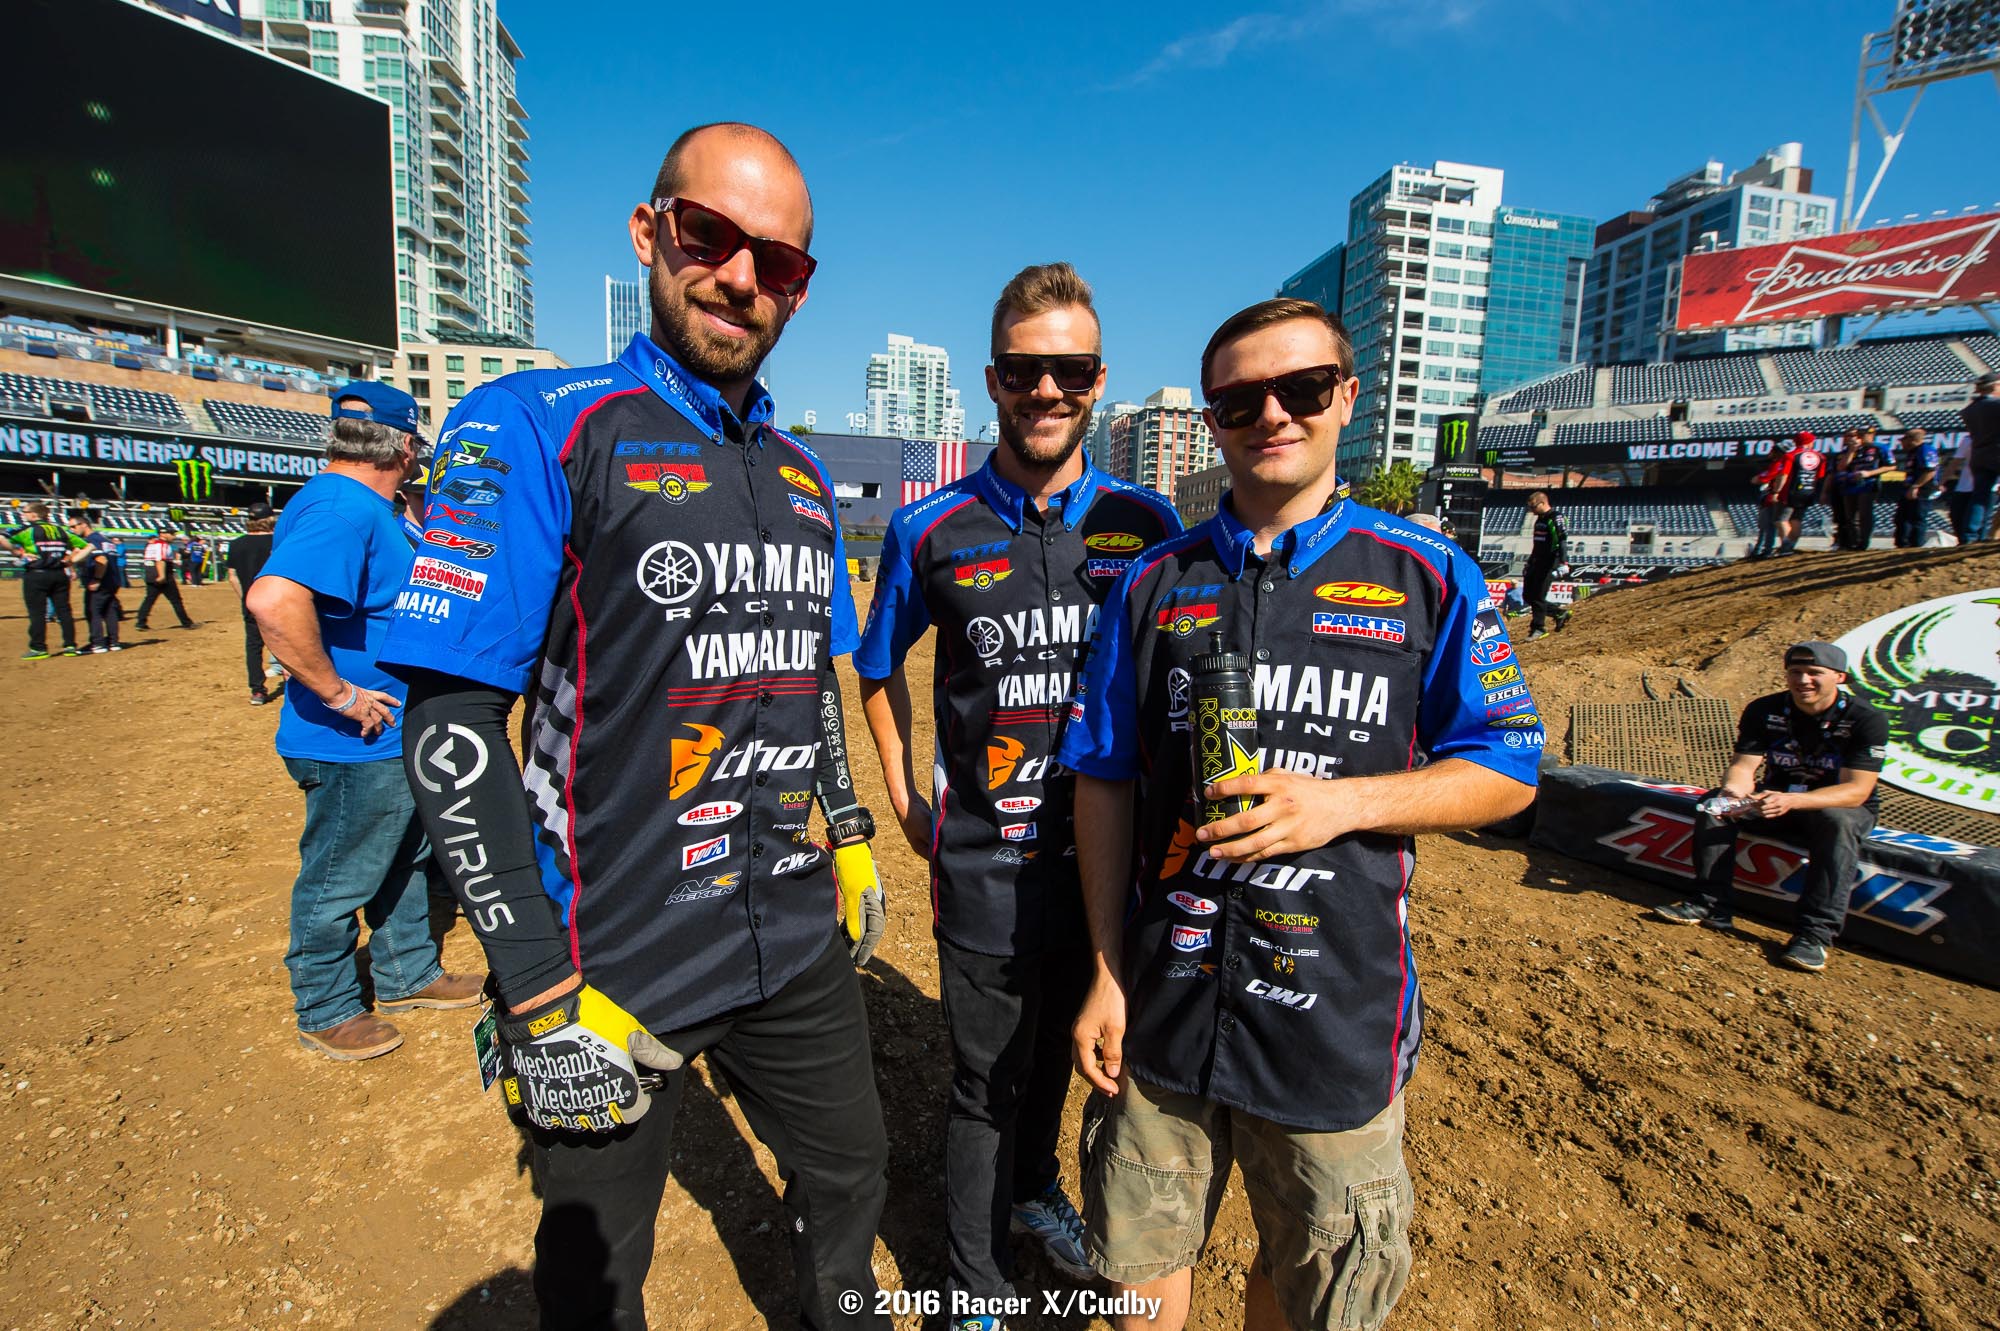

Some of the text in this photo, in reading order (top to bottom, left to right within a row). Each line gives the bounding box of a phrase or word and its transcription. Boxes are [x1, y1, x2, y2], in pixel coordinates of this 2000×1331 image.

[1745, 250, 1990, 297] Budweiser
[556, 378, 614, 398] DUNLOP
[665, 370, 708, 416] YAMAHA
[805, 410, 816, 426] 6
[846, 412, 866, 428] 19
[894, 415, 913, 432] 31
[941, 418, 963, 435] 35
[990, 421, 999, 436] 5
[0, 428, 330, 477] NSTER ENERGY SUPERCROS
[614, 440, 702, 456] GYTR
[778, 432, 820, 460] DUNLO
[1629, 441, 1738, 460] WELCOME
[1744, 440, 1775, 456] TO
[1088, 535, 1143, 546] FMF
[1388, 528, 1455, 557] DUNLOP
[437, 561, 473, 578] TOYOTA
[704, 543, 834, 598] YAMAH
[1088, 559, 1131, 570] PAR
[412, 579, 478, 600] ACTION SPORTS
[413, 565, 484, 595] ESCONDIDO
[1316, 586, 1405, 601] FMF
[394, 592, 451, 618] MAHA
[666, 600, 833, 621] RACING
[400, 612, 441, 624] ING
[1003, 604, 1101, 648] YAMA
[1314, 613, 1405, 634] PARTS
[1313, 625, 1404, 643] UNLIMITED
[985, 649, 1079, 668] RACI
[998, 672, 1075, 707] YAMAL
[1256, 664, 1389, 726] MAHA
[1487, 685, 1527, 703] EXCEL
[1523, 731, 1546, 745] YA
[687, 804, 737, 821] BELL
[1001, 799, 1038, 808] BELL
[690, 839, 723, 866] 100%
[439, 796, 516, 932] VIRUS
[665, 885, 738, 905] NEKEN
[1176, 894, 1212, 910] BELL
[1175, 931, 1206, 946] 100%
[1250, 937, 1319, 957] REKLUSE
